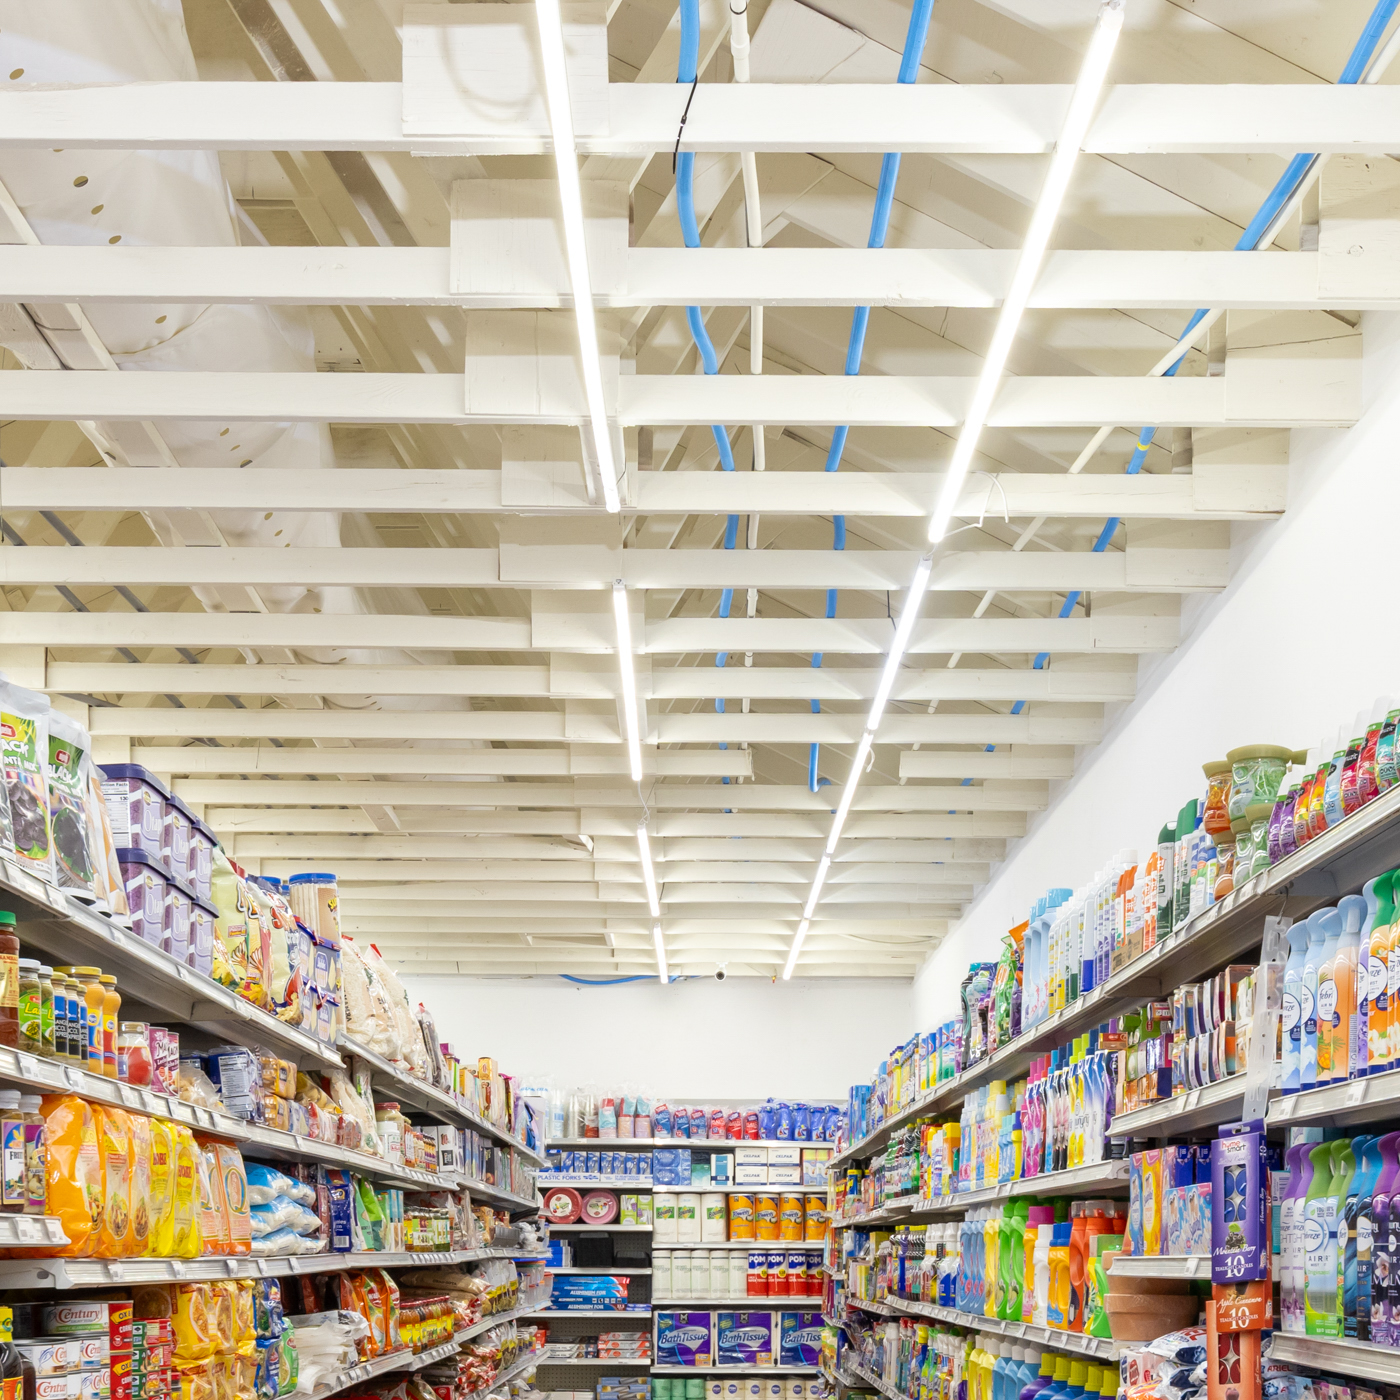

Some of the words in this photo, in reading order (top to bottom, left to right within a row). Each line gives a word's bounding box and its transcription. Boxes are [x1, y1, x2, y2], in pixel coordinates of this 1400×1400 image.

[1224, 1256, 1246, 1278] 10
[58, 1308, 100, 1322] Century
[660, 1331, 709, 1344] BathTissue
[719, 1331, 768, 1344] BathTissue
[782, 1331, 821, 1344] BathTiss
